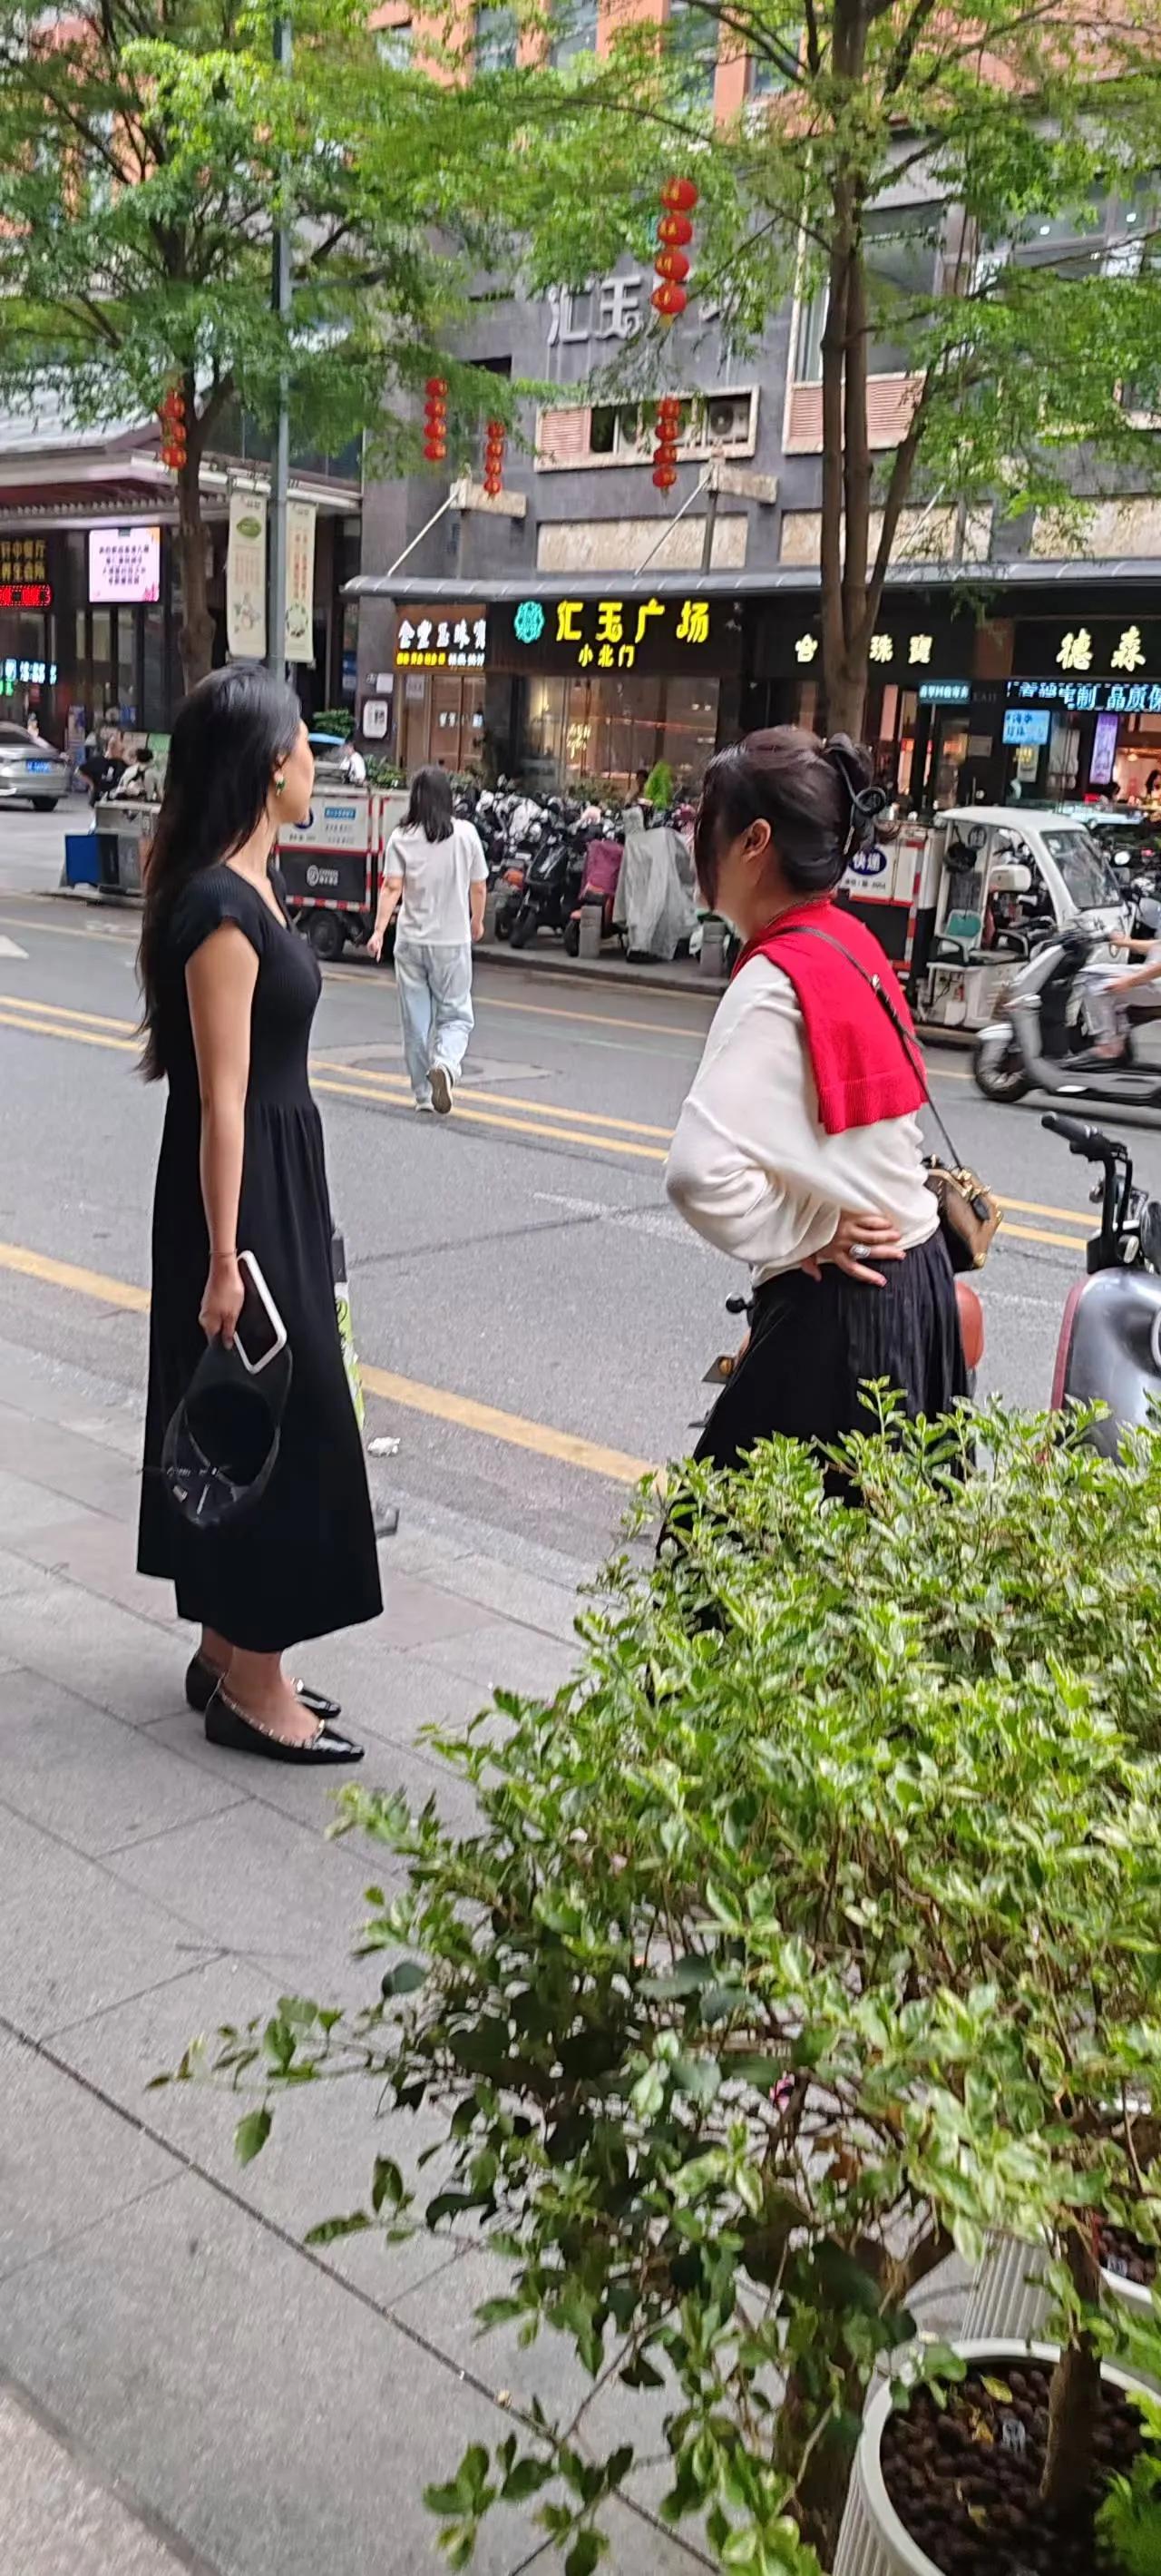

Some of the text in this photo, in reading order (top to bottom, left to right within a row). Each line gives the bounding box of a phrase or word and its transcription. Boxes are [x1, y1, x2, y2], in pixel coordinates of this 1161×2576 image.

[556, 598, 709, 643] 汇玉广场
[578, 642, 635, 668] 小北门
